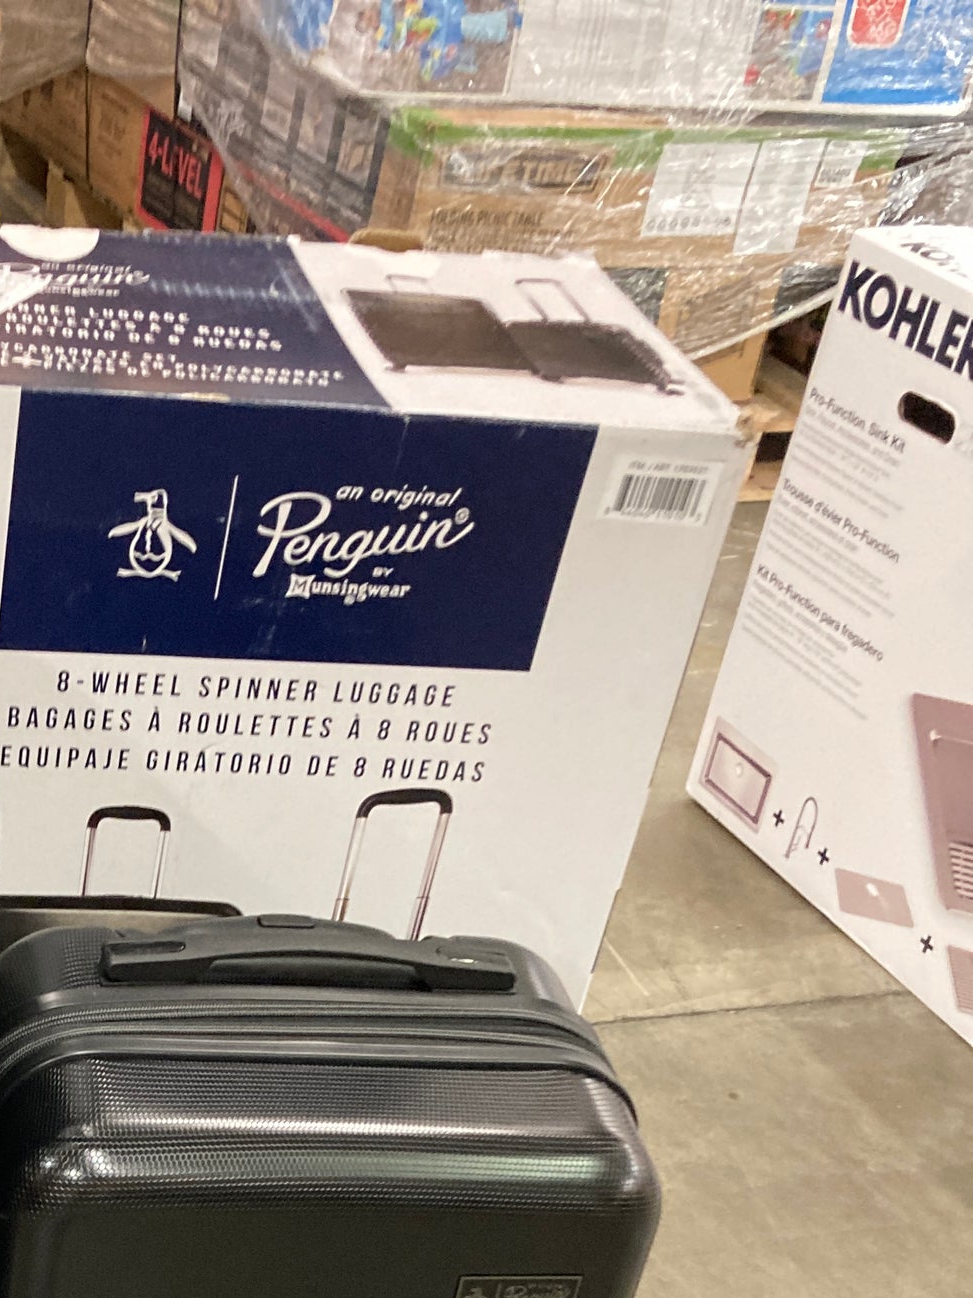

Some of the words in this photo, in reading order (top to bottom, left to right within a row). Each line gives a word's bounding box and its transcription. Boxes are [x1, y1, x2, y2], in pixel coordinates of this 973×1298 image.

[809, 387, 866, 431] Pro-Function
[868, 421, 890, 446] Sink
[890, 435, 906, 454] Kit
[335, 485, 365, 501] an
[370, 483, 463, 511] original
[842, 517, 900, 564] Pro-Function
[284, 573, 413, 605] Munsingwear
[371, 566, 395, 578] BY
[756, 563, 770, 582] Kit
[769, 571, 821, 618] Pro-Function
[819, 611, 841, 632] para
[841, 622, 884, 662] fregadero
[56, 669, 181, 698] 8-WHEEL
[198, 675, 318, 703] SPINNER
[332, 680, 456, 708] LUGGAGE
[7, 705, 132, 733] BAGAGES
[147, 705, 160, 733] À
[178, 711, 333, 739] ROULETTES
[346, 713, 361, 740] À
[377, 718, 392, 741] 8
[405, 720, 492, 745] ROUES
[0, 745, 131, 771] EQUIPAJE
[145, 749, 292, 776] GIRATORIO
[306, 754, 340, 777] DE
[353, 756, 368, 778] 8
[381, 757, 485, 783] RUEDAS
